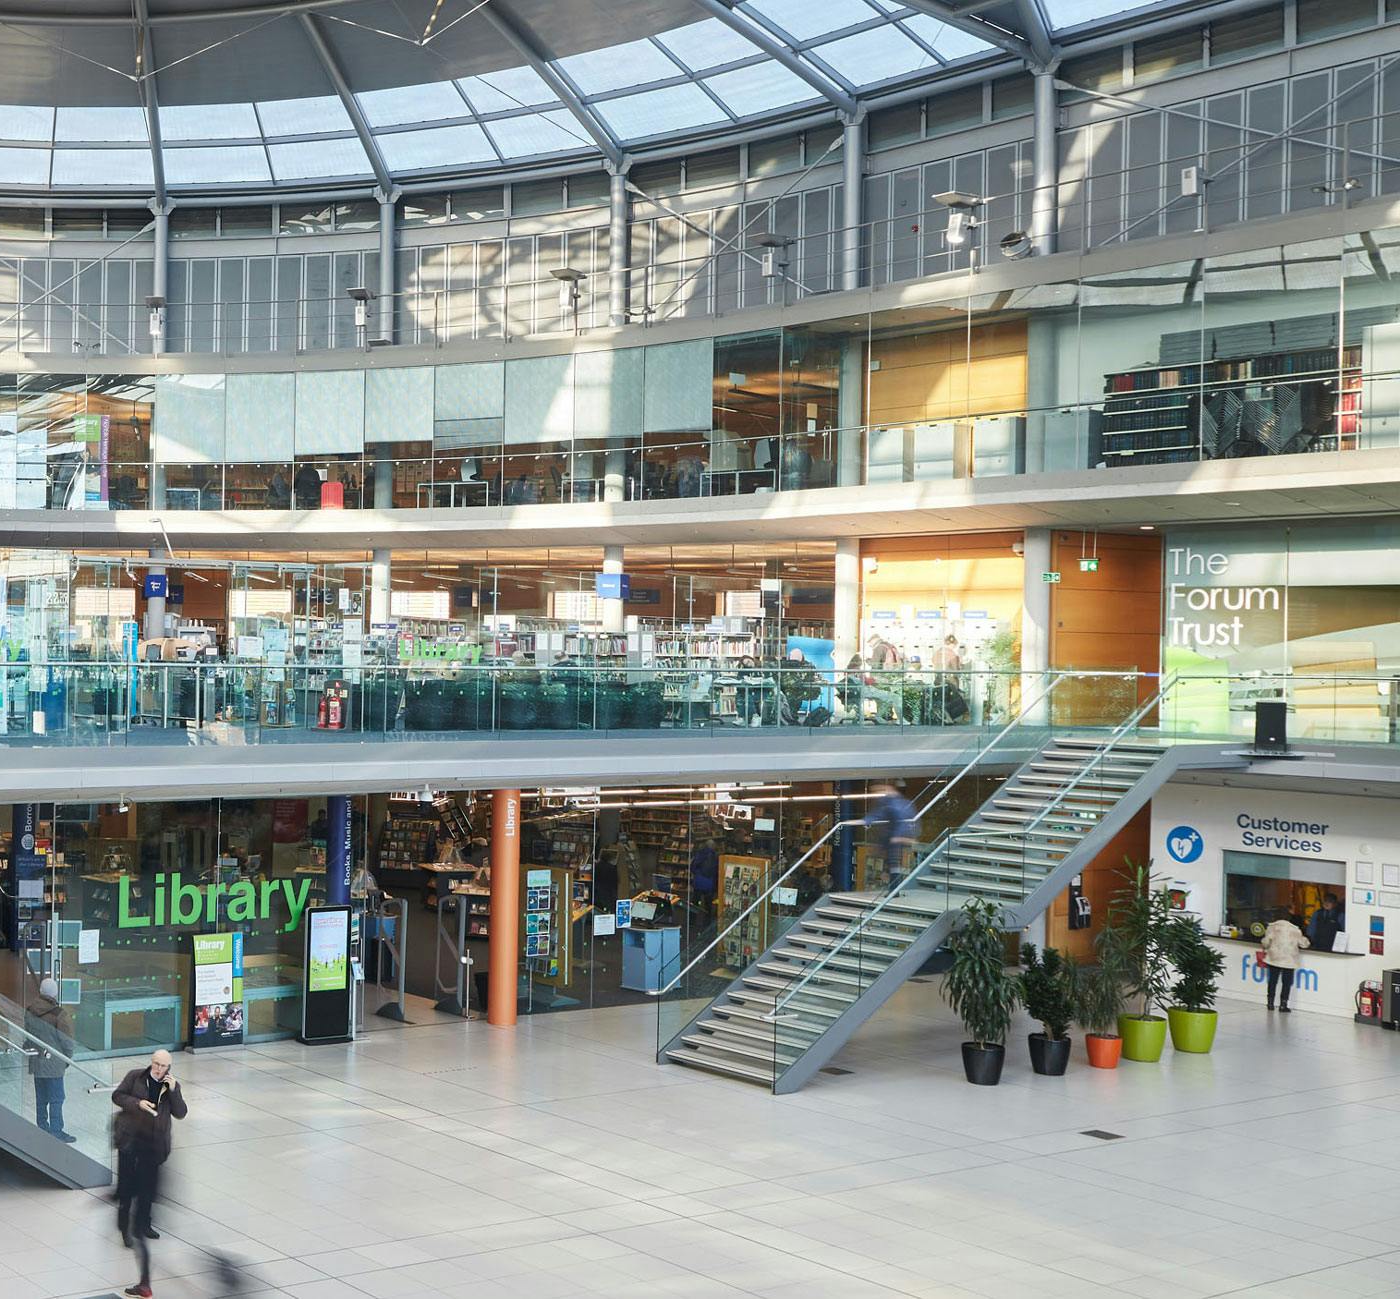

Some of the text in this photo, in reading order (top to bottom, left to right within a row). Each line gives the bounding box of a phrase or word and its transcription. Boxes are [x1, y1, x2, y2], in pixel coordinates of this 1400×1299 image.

[1168, 547, 1229, 575] The
[1170, 583, 1280, 611] Forum
[1168, 616, 1245, 646] Trust
[400, 638, 482, 666] Library
[505, 798, 518, 837] Library
[1236, 813, 1329, 836] Customer
[1241, 831, 1323, 853] Services
[118, 872, 312, 932] Library
[195, 940, 225, 951] Library
[1242, 953, 1318, 992] fom
